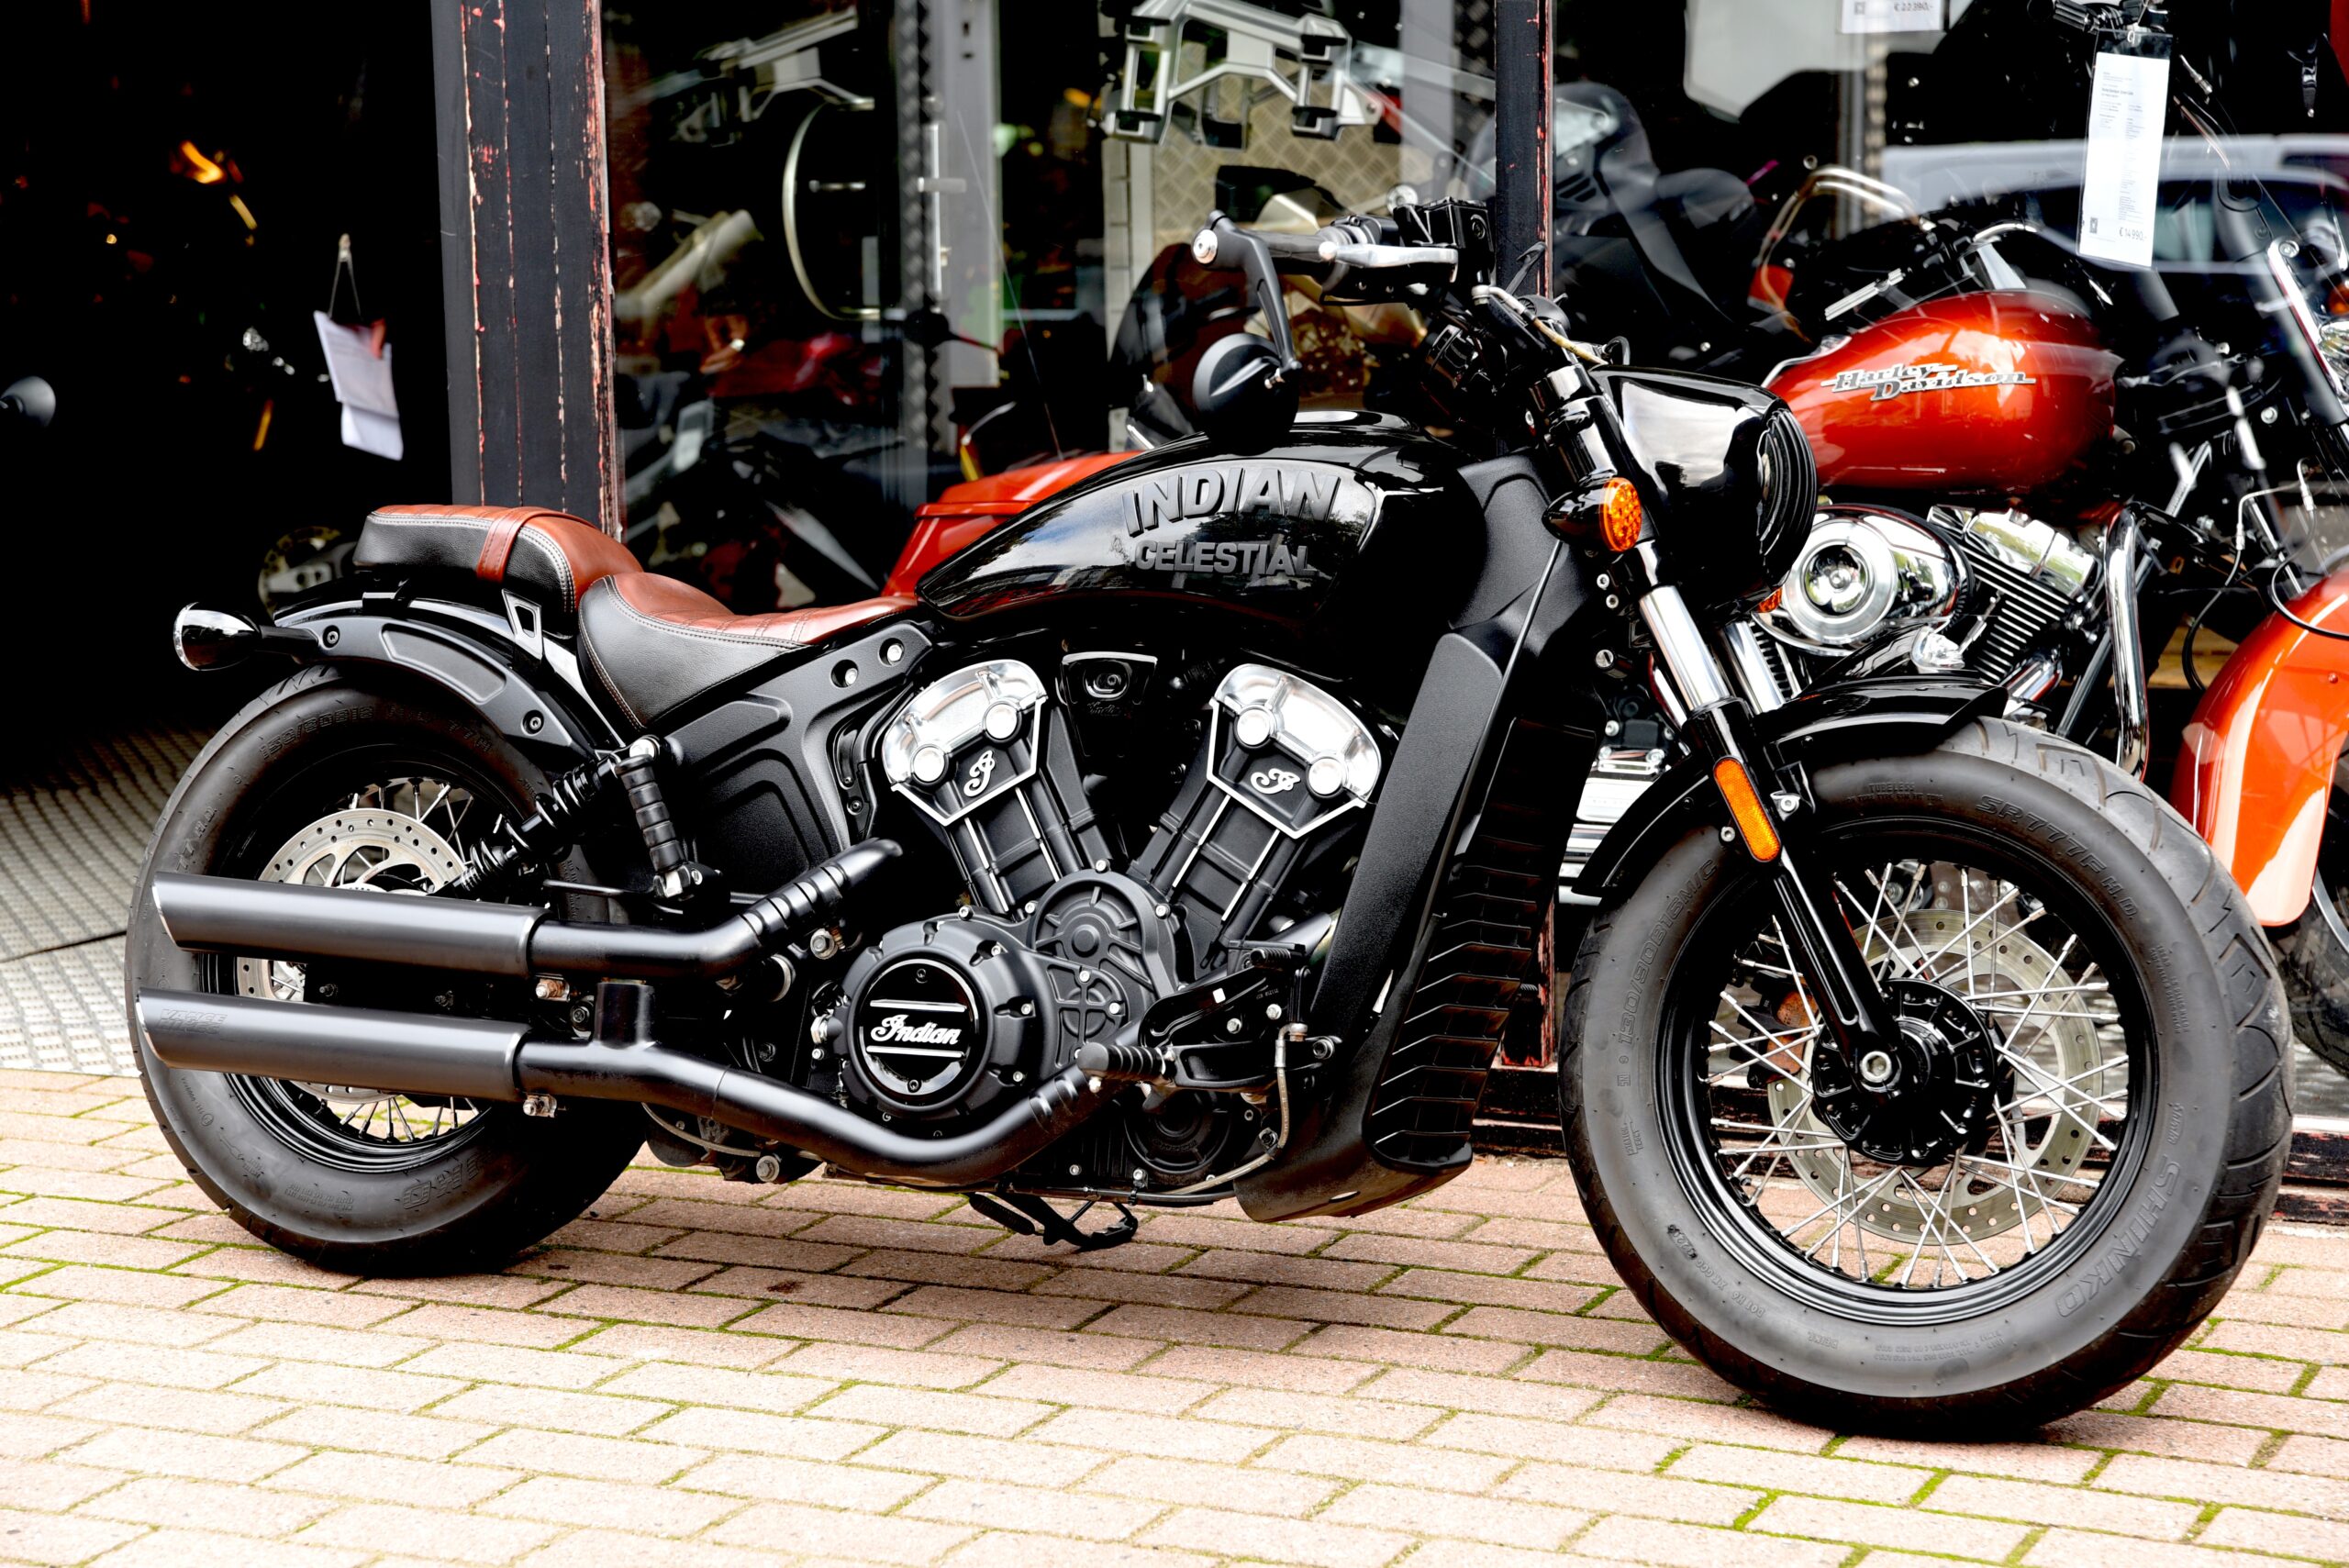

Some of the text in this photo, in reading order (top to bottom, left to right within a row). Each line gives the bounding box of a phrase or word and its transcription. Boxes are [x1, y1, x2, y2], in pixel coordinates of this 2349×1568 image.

[1871, 372, 2036, 401] Davidson
[1122, 467, 1341, 538] INDIAN
[1135, 540, 1317, 577] CELESTIAL
[1869, 782, 1914, 793] TUBELESS
[2102, 877, 2138, 920] H.D.
[870, 1014, 963, 1045] Indian
[2054, 1154, 2181, 1319] SHINKO
